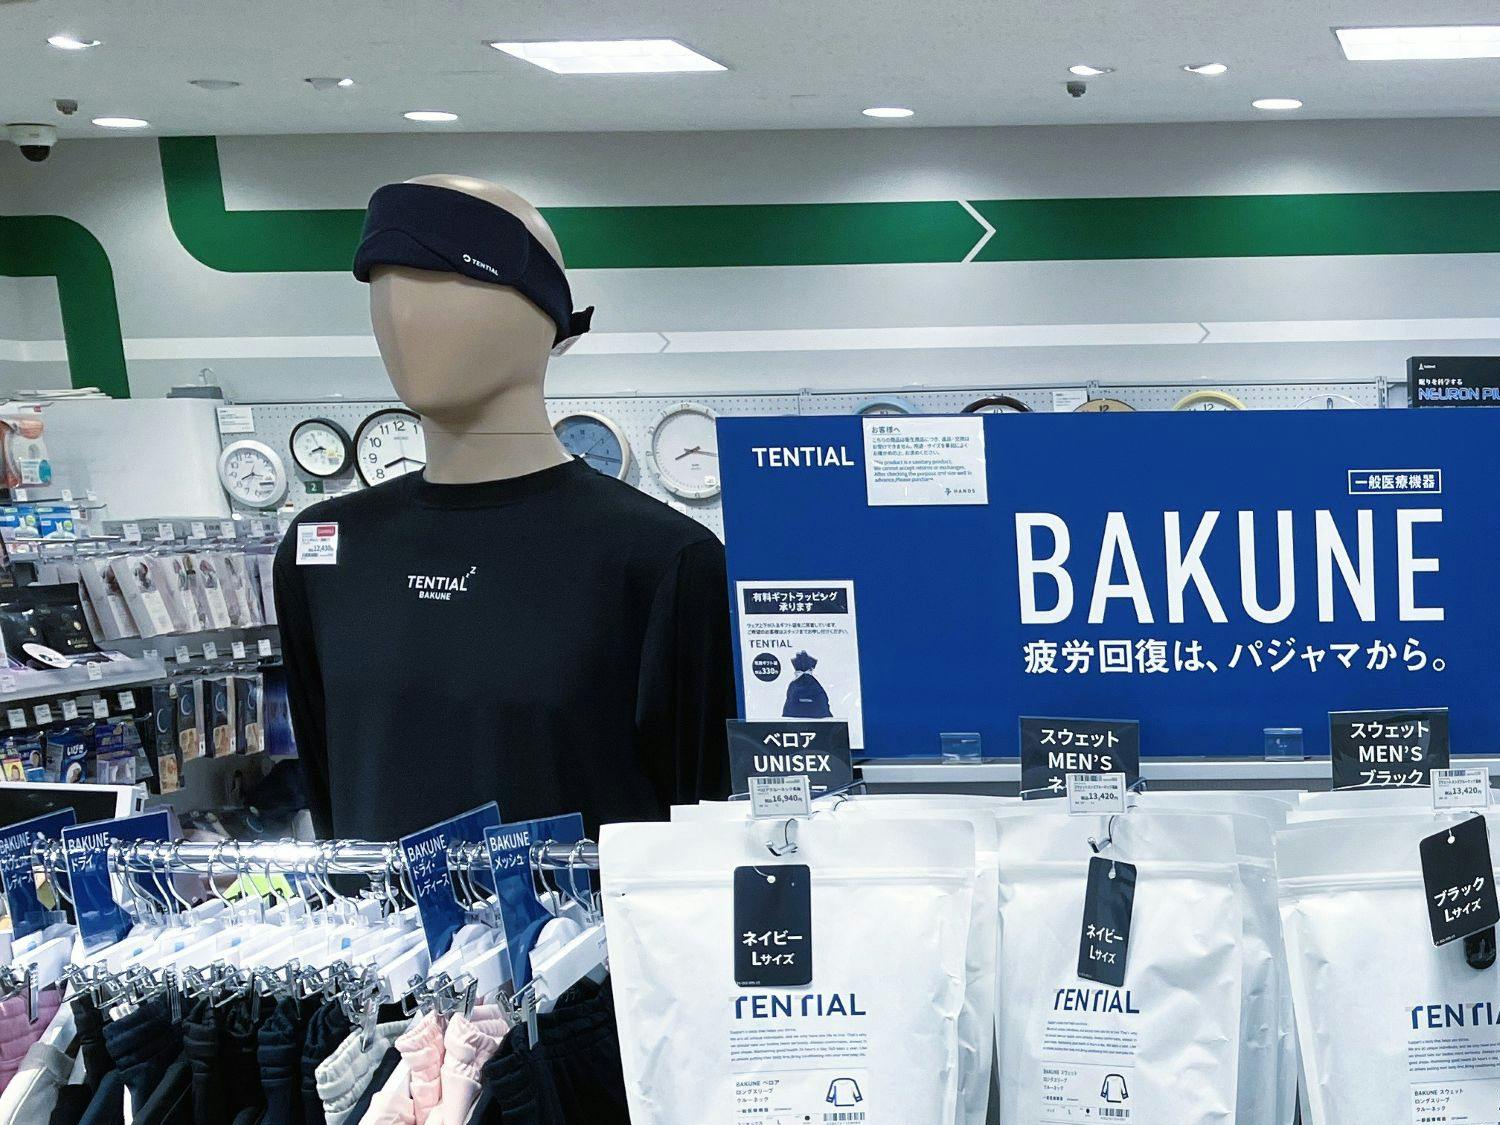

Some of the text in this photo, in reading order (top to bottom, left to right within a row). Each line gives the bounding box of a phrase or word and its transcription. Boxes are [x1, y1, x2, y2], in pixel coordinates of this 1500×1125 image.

[471, 258, 499, 276] TENTIAL
[1418, 387, 1480, 400] NEURON
[380, 425, 390, 435] 11
[392, 421, 405, 432] 12
[369, 438, 382, 448] 10
[368, 453, 377, 463] 9
[752, 446, 854, 467] TENTIAL
[376, 469, 385, 479] 8
[1353, 473, 1437, 491] 一般医療機器
[311, 483, 317, 491] 2
[1014, 507, 1443, 626] BAKUNE
[407, 574, 468, 592] TENTIAL
[419, 591, 452, 601] BAKUNE
[753, 591, 838, 602] 有料ギフトラッピング
[779, 602, 813, 612] 承ります
[750, 640, 792, 648] TENTIAL
[1022, 637, 1449, 676] 疲労回復は、パジャマから。
[1040, 727, 1120, 747] スウェット
[1350, 720, 1429, 740] スウェット
[763, 731, 817, 748] ベロア
[754, 755, 832, 773] UNISEX
[1359, 768, 1424, 788] ブラック
[68, 832, 110, 850] BAKUNE
[407, 834, 447, 862] BAKUNE
[489, 831, 530, 851] BAKUNE
[71, 854, 93, 872] ドライ
[495, 853, 525, 870] メッシュ
[417, 873, 449, 897] レディース
[1434, 876, 1485, 906] ブラック
[1444, 898, 1482, 923] Lサイズ
[742, 931, 803, 946] ネイビー
[1087, 923, 1124, 944] ネイビー
[751, 951, 795, 966] Lサイズ
[1089, 945, 1116, 964] Lサイズ
[729, 994, 866, 1020] TENTIAL
[1052, 988, 1140, 1014] TENTIAL
